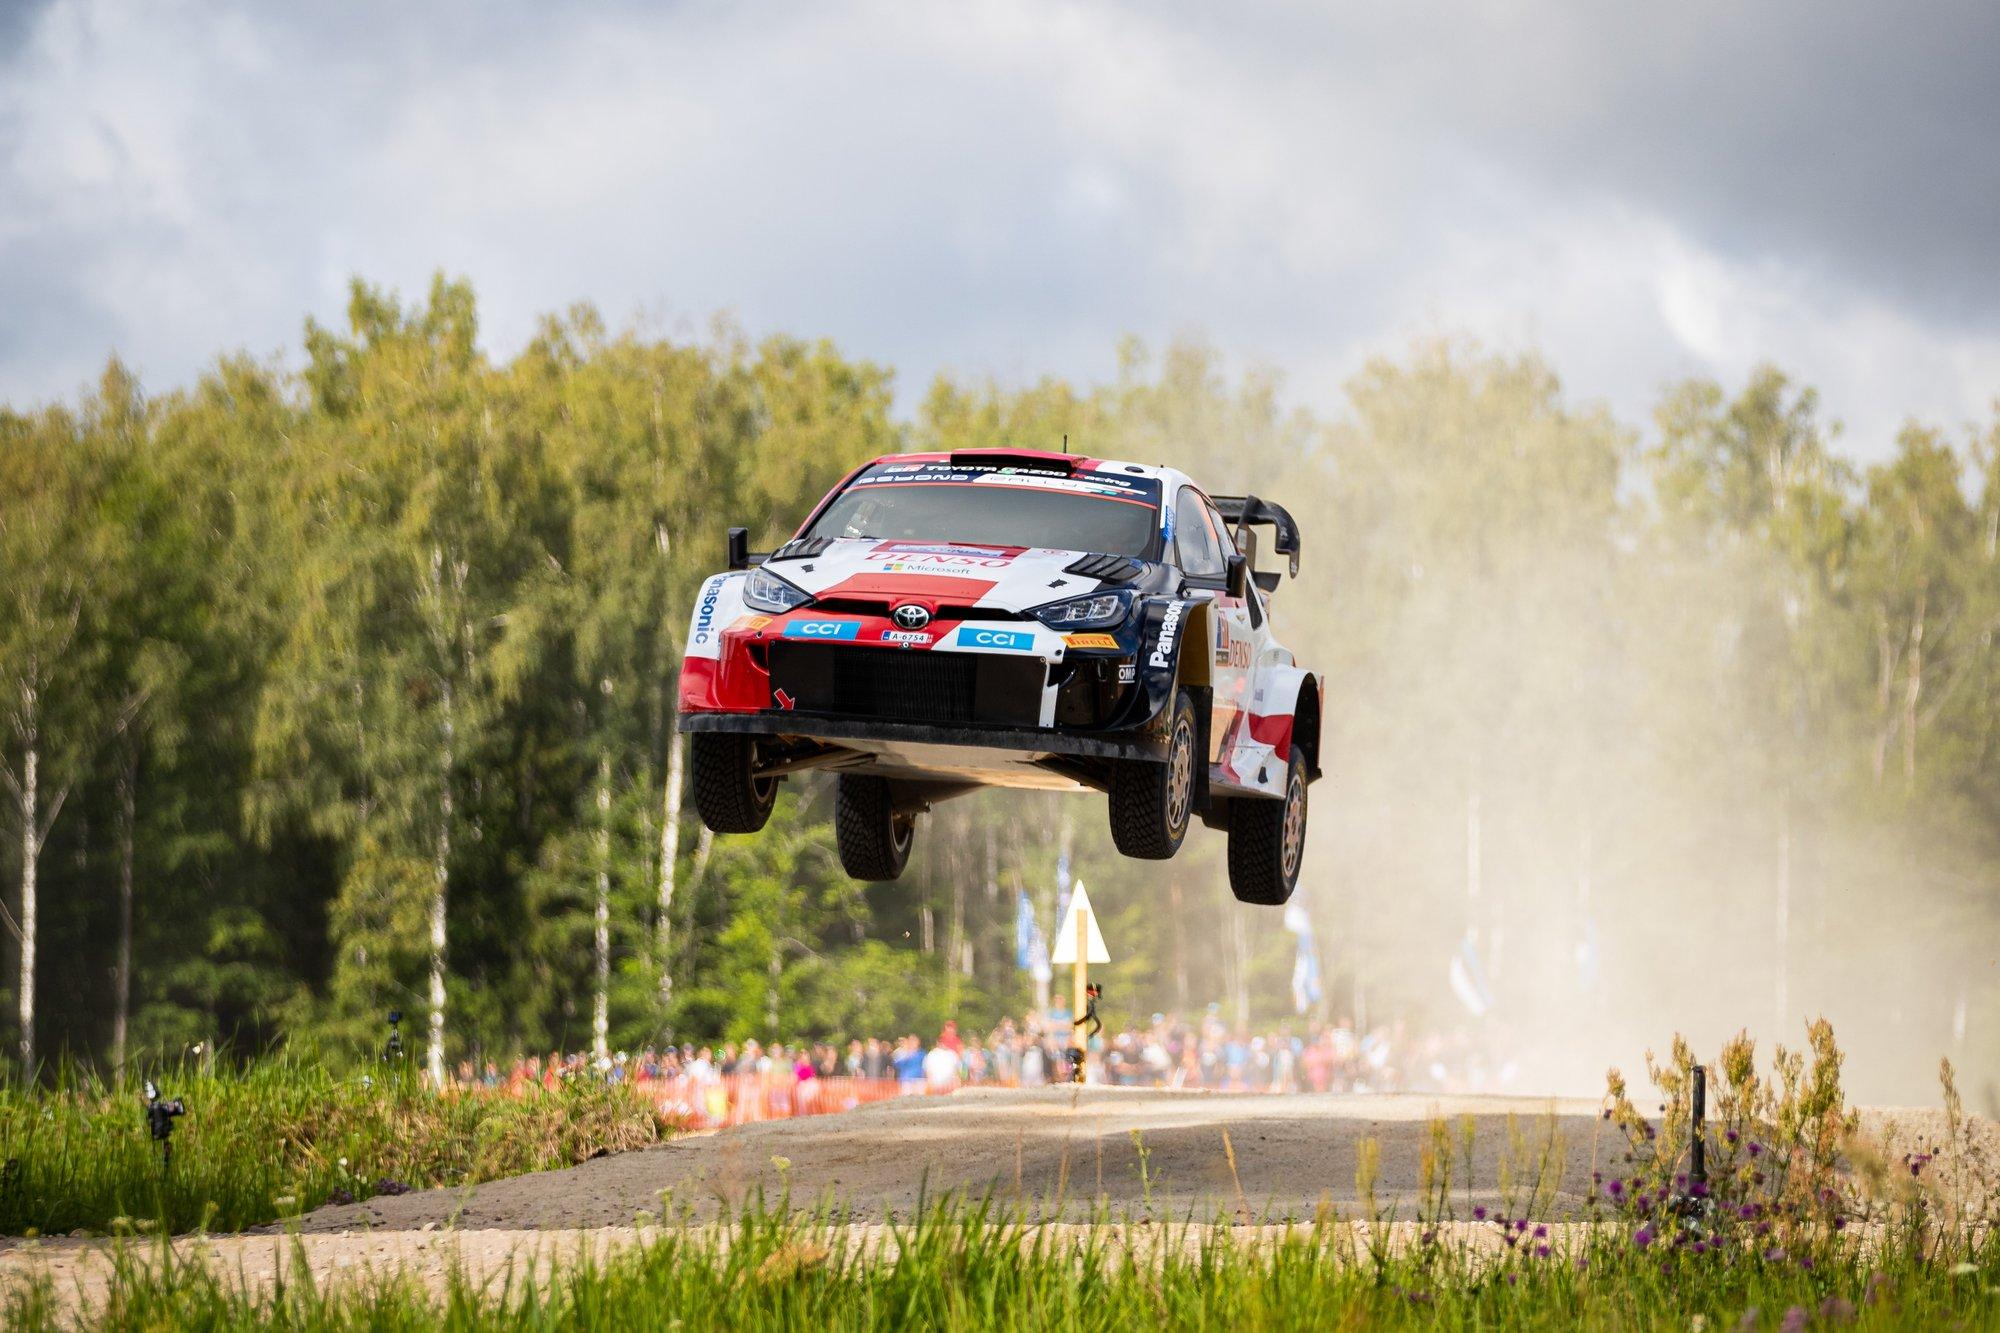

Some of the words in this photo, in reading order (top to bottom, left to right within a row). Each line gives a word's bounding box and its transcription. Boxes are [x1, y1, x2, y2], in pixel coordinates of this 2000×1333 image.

[865, 552, 1011, 568] DENSO
[907, 564, 970, 575] Microsoft
[802, 623, 841, 635] CCI
[891, 633, 924, 641] A-6754
[976, 632, 1015, 646] CCI
[1118, 668, 1136, 680] OMP
